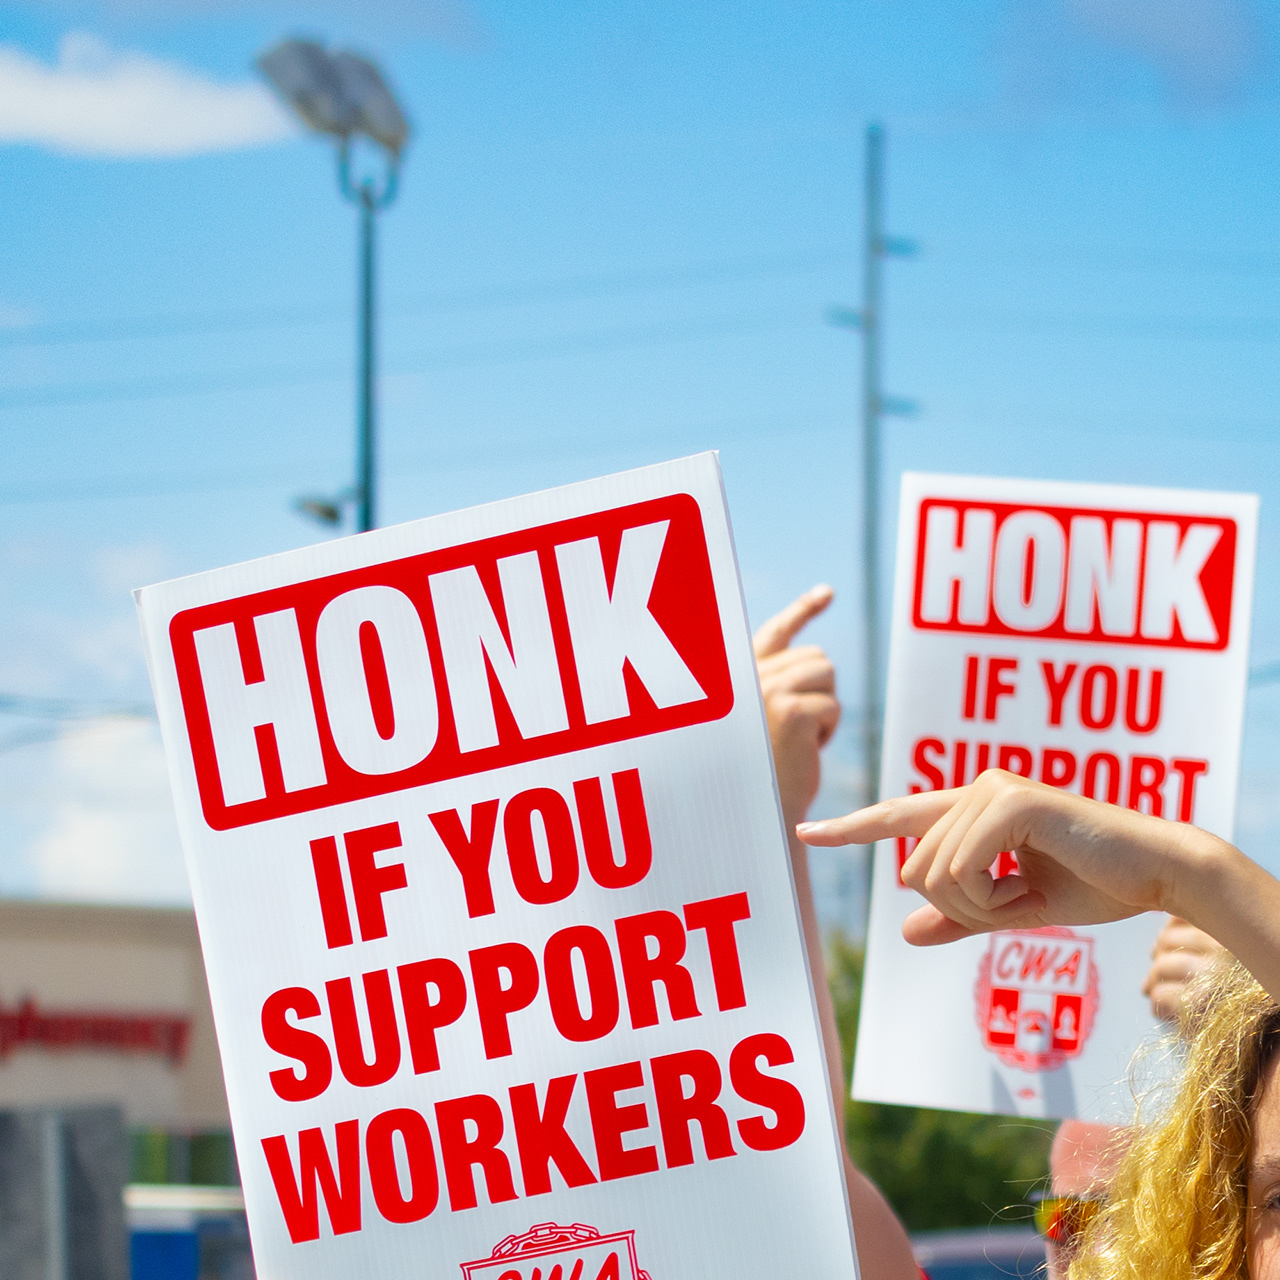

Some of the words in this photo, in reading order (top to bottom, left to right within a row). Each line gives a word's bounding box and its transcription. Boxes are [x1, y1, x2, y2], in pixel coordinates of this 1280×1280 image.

[193, 519, 708, 807] HONK
[919, 506, 1224, 644] HONK
[963, 654, 1016, 722] IF
[1040, 661, 1164, 735] YOU
[309, 821, 408, 949] IF
[428, 767, 653, 918] YOU
[261, 891, 751, 1103] SUPPORT
[995, 940, 1082, 985] CWA
[260, 1032, 806, 1245] WORKERS
